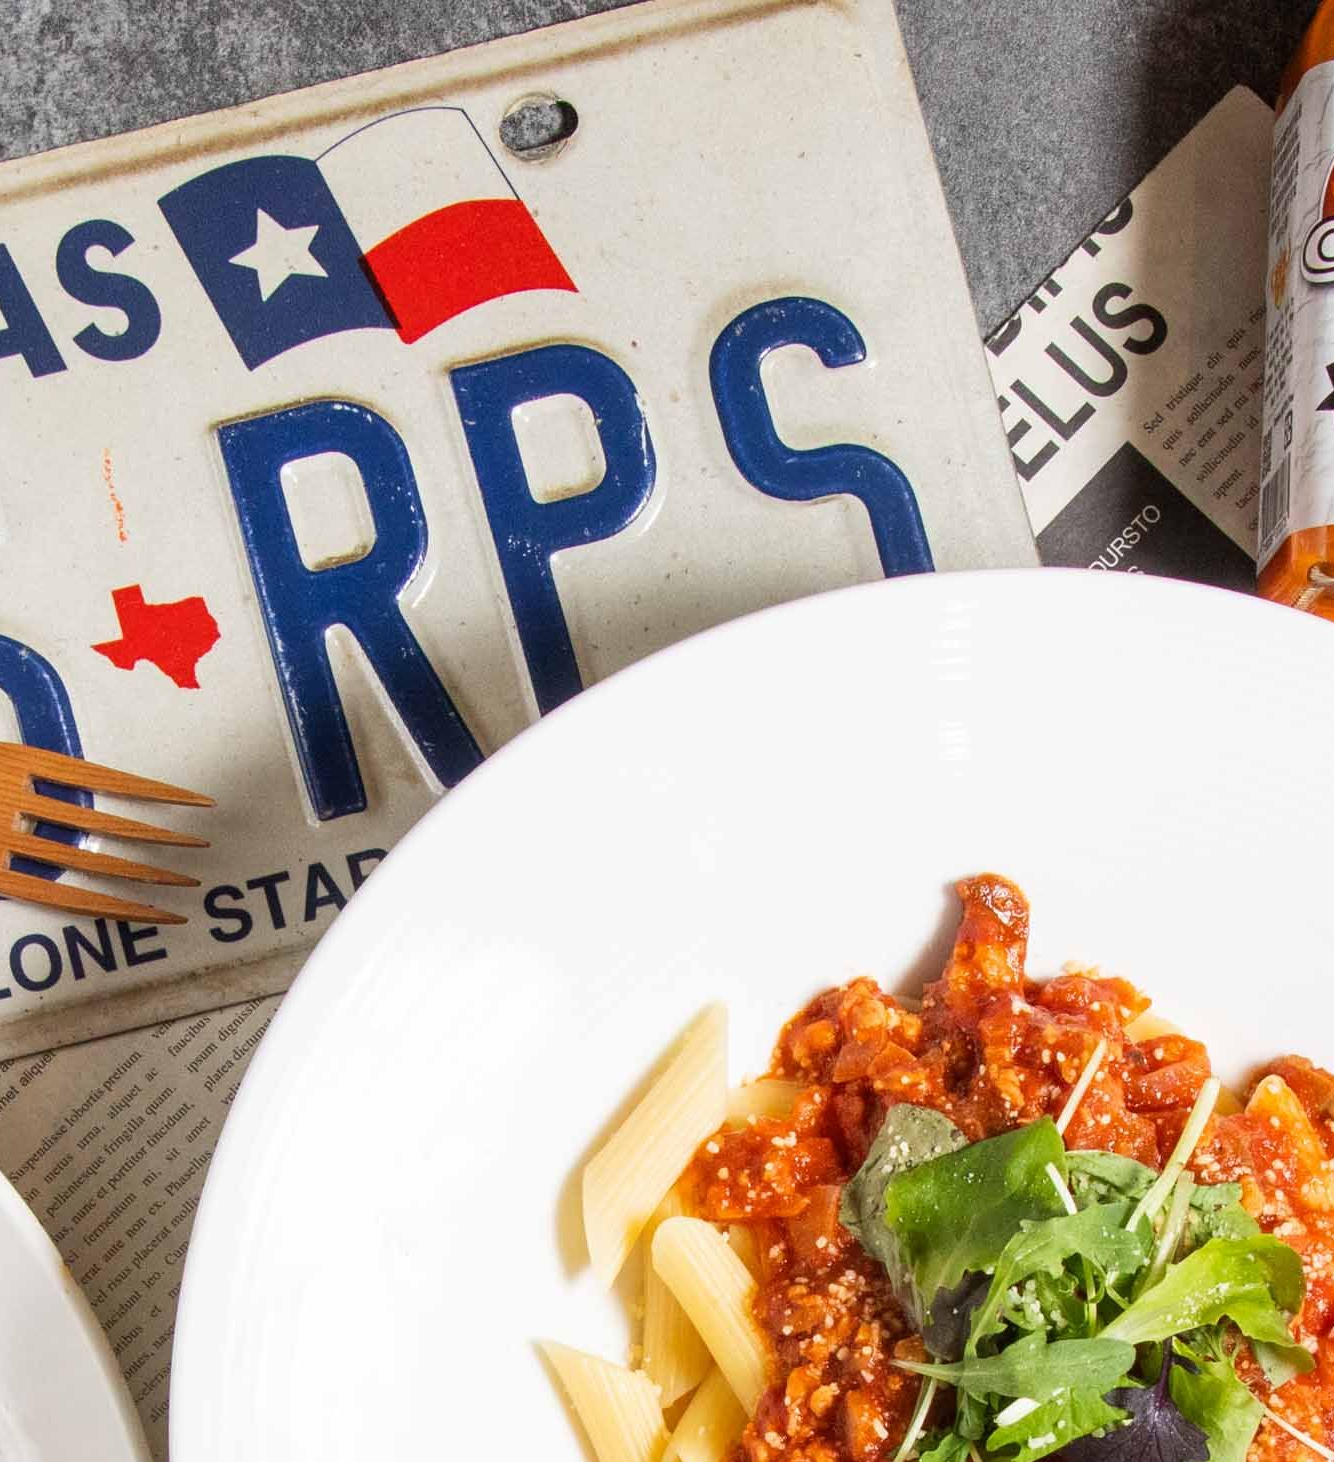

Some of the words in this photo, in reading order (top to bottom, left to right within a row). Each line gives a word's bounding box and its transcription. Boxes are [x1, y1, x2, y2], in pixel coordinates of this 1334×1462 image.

[1142, 411, 1166, 436] Sed
[1164, 370, 1205, 413] tristique
[1205, 350, 1225, 371] elit
[1224, 326, 1248, 351] quis
[1160, 427, 1184, 452] quis
[1184, 372, 1236, 427] sollicitudin
[1177, 446, 1197, 467] nec
[1215, 407, 1234, 428] sed
[1232, 392, 1249, 411] mi
[1194, 430, 1246, 484] sollicitudin
[1244, 414, 1260, 430] id
[167, 1012, 212, 1058] faucibus
[184, 1040, 220, 1075] ipsum
[202, 1058, 236, 1093] platea
[5, 1122, 69, 1185] Suspendisse
[63, 1085, 107, 1128] lobortis
[100, 1048, 144, 1093] pretium
[42, 1152, 75, 1185] metus
[106, 1083, 144, 1121] aliquet
[143, 1066, 160, 1083] ac
[69, 1196, 97, 1225] nunc
[94, 1184, 110, 1200] et
[105, 1144, 149, 1190] porttitor
[145, 1099, 196, 1149] tincidunt,
[44, 1154, 107, 1218] pellentesque
[101, 1114, 147, 1157] fringilla
[81, 1191, 138, 1247] fermentum
[164, 1146, 181, 1164] sit
[183, 1115, 212, 1144] amet
[100, 1237, 126, 1263] ante
[123, 1214, 149, 1240] non
[163, 1148, 214, 1198] Phasellus
[105, 1264, 134, 1293] risus
[129, 1224, 173, 1270] placerat
